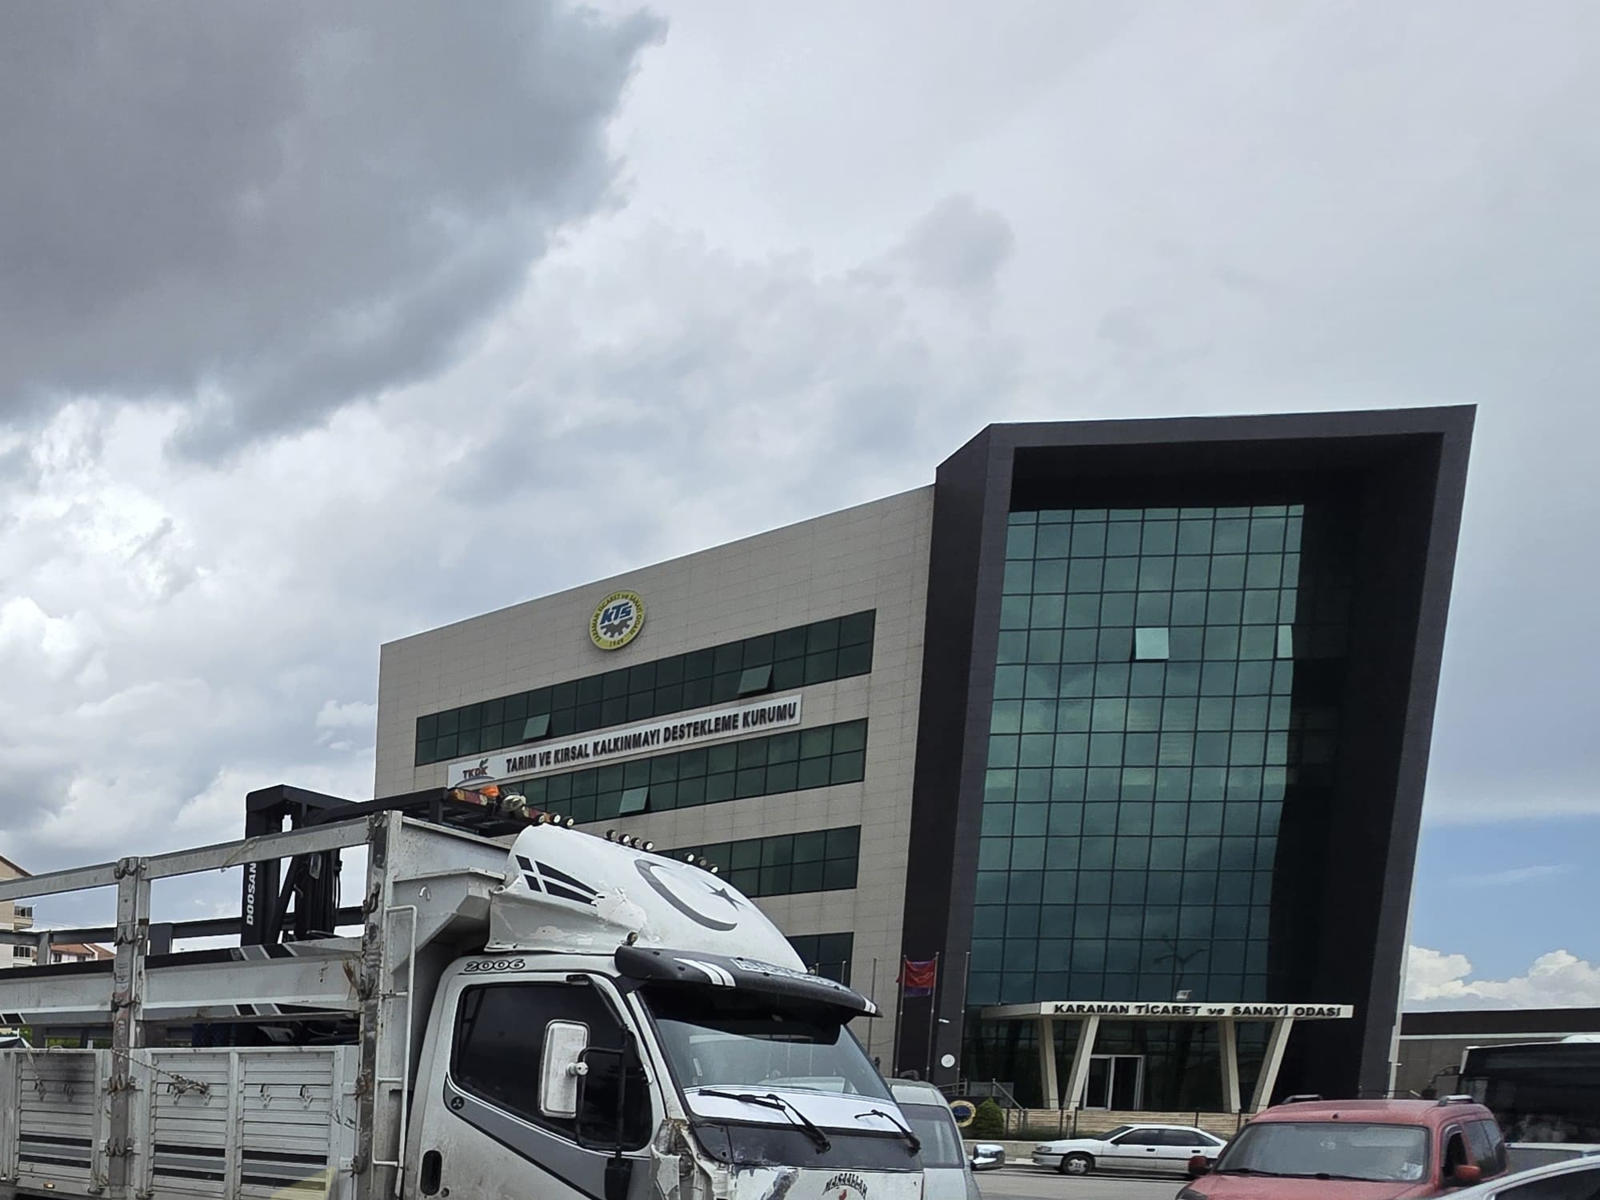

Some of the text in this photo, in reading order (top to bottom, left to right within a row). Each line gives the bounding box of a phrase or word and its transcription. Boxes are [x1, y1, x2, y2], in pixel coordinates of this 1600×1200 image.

[599, 602, 633, 625] KTS
[506, 702, 797, 773] TARIM VE KIRSAL KALKINMAYI DESTEKLEME KURUMU
[246, 862, 257, 926] DOOSAN
[464, 959, 526, 972] 2006
[1053, 1004, 1341, 1017] KARAMAN TİCARET ve SANAYİ ODASI
